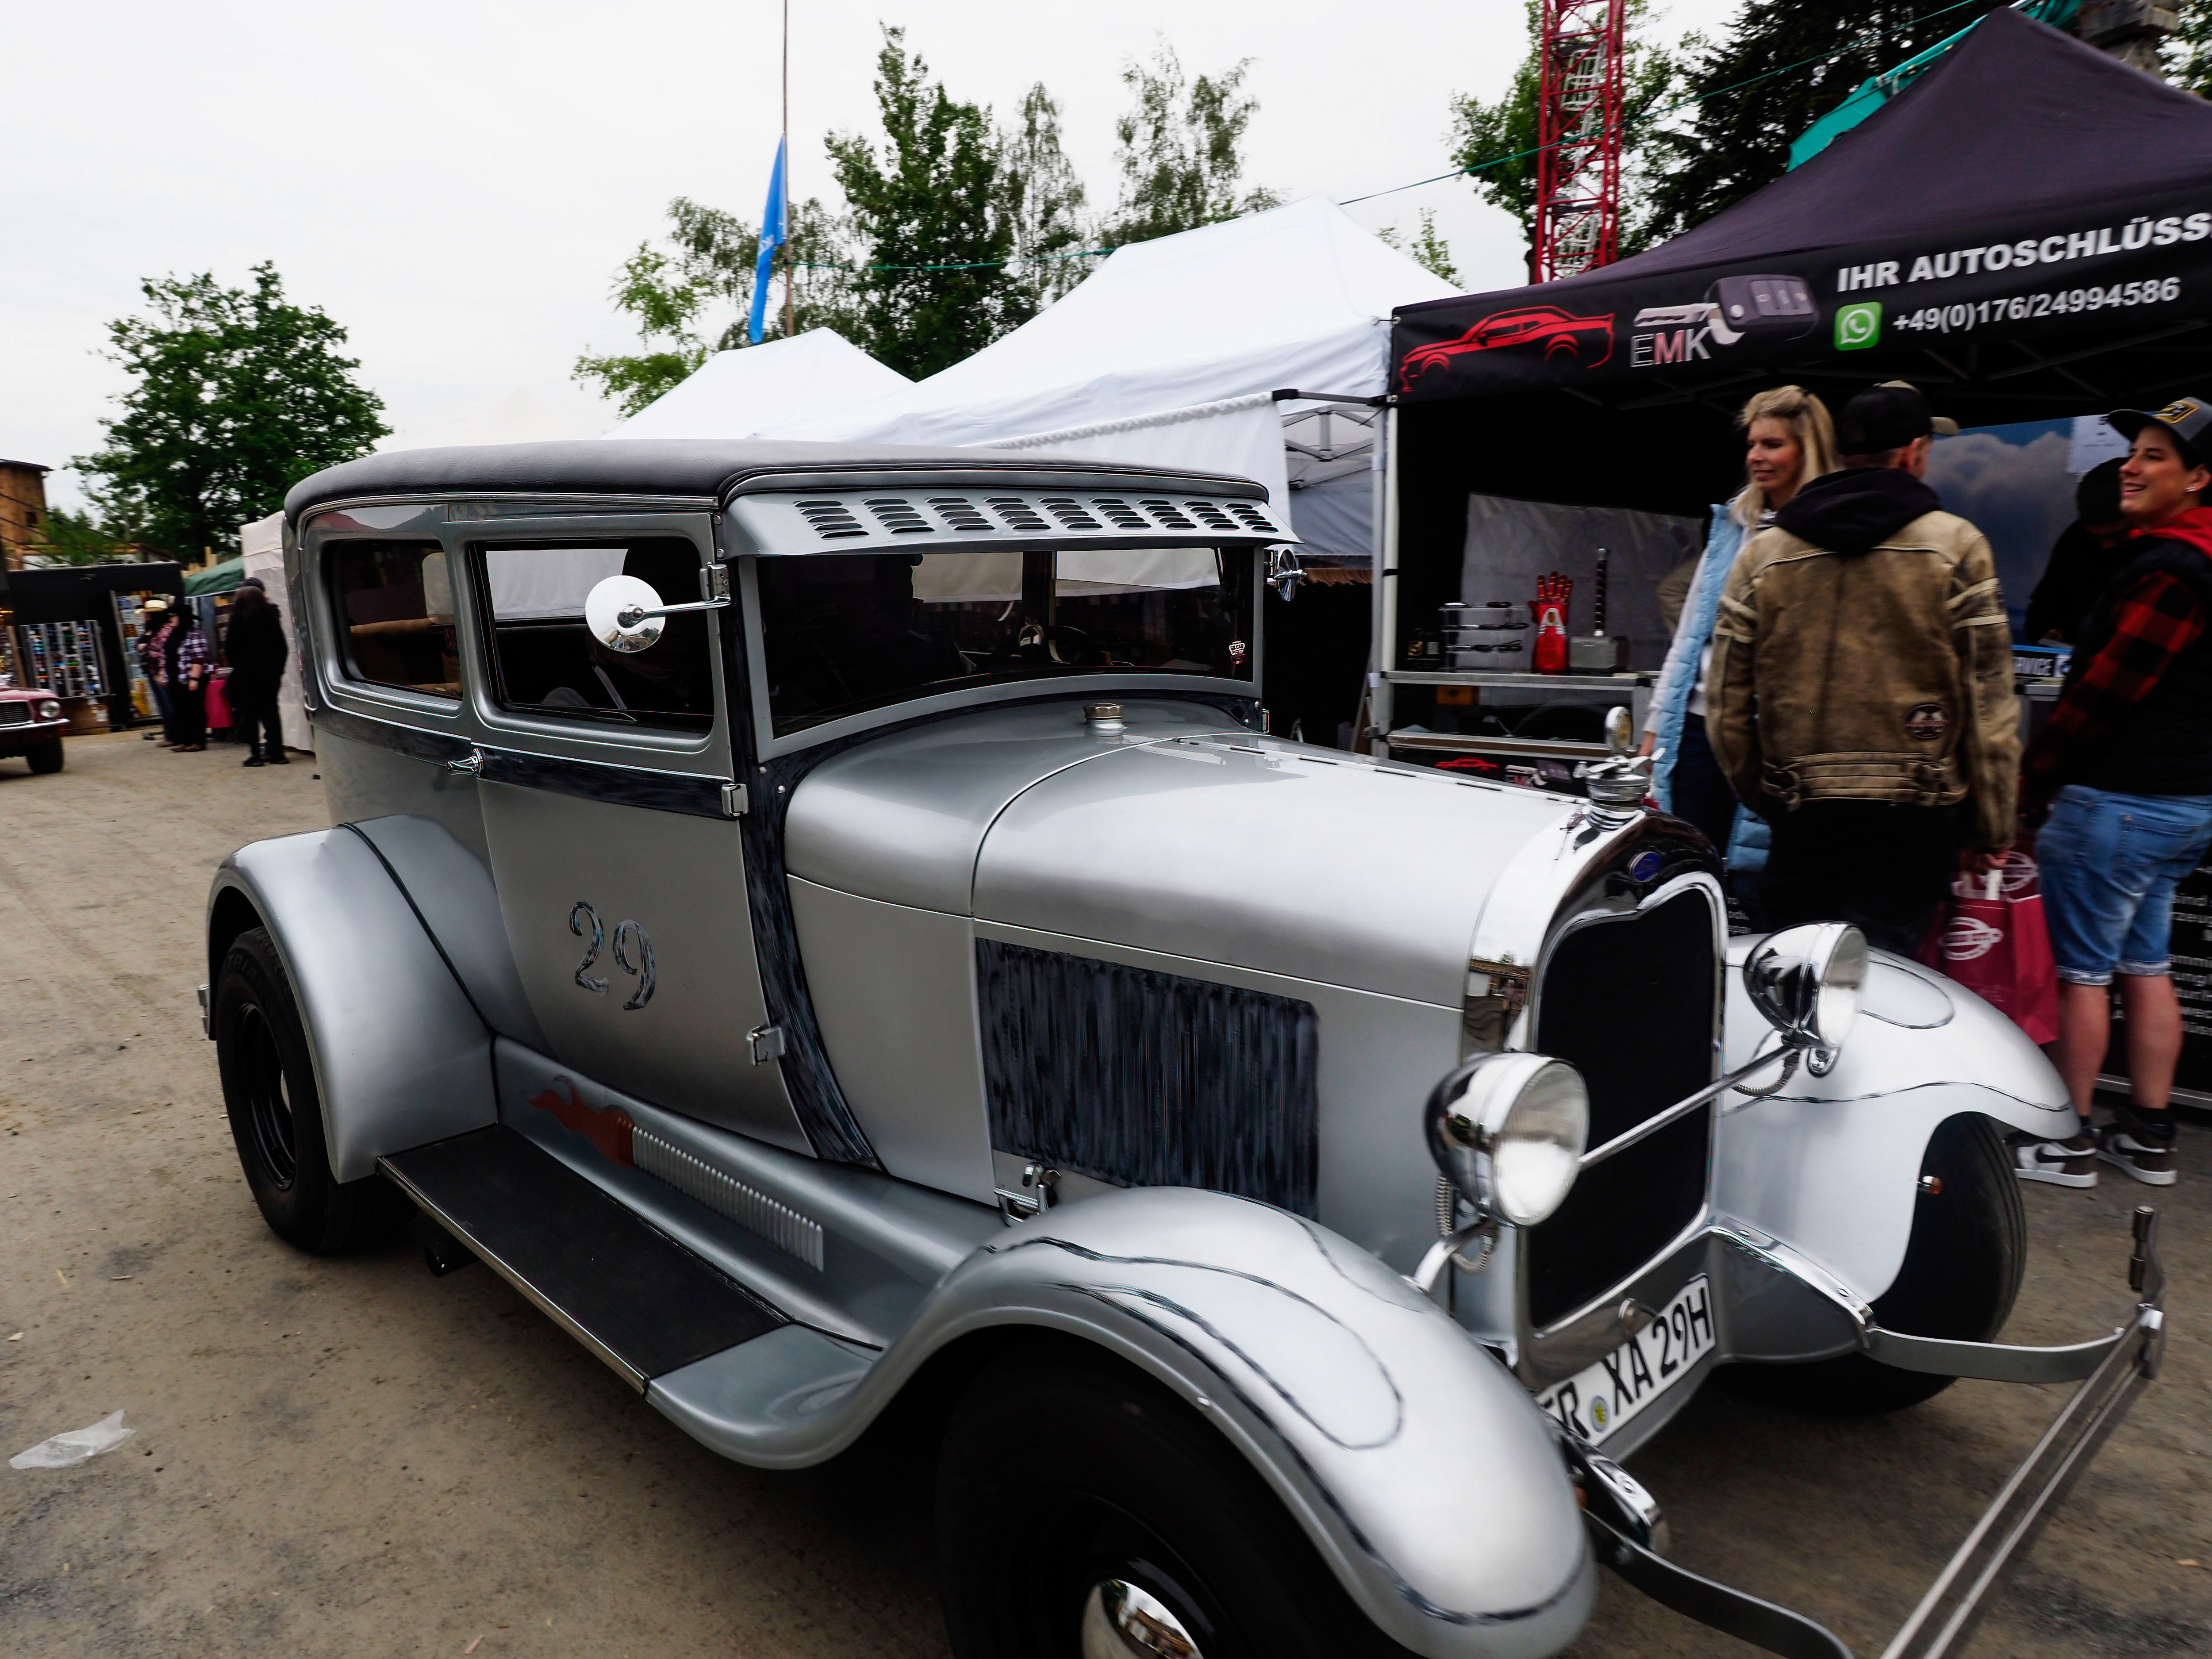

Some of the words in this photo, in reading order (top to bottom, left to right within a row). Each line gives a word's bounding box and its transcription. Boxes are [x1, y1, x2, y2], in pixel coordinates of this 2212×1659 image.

[1838, 260, 1900, 292] IHR
[1907, 212, 2212, 282] AUTOSCHLÜSS
[1892, 276, 2181, 333] +49(0)176/24994586
[1630, 326, 1712, 367] EMK
[569, 901, 656, 1010] 29
[1543, 1381, 1590, 1440] R
[1601, 1334, 1654, 1417] XA
[1651, 1286, 1712, 1379] 29H
